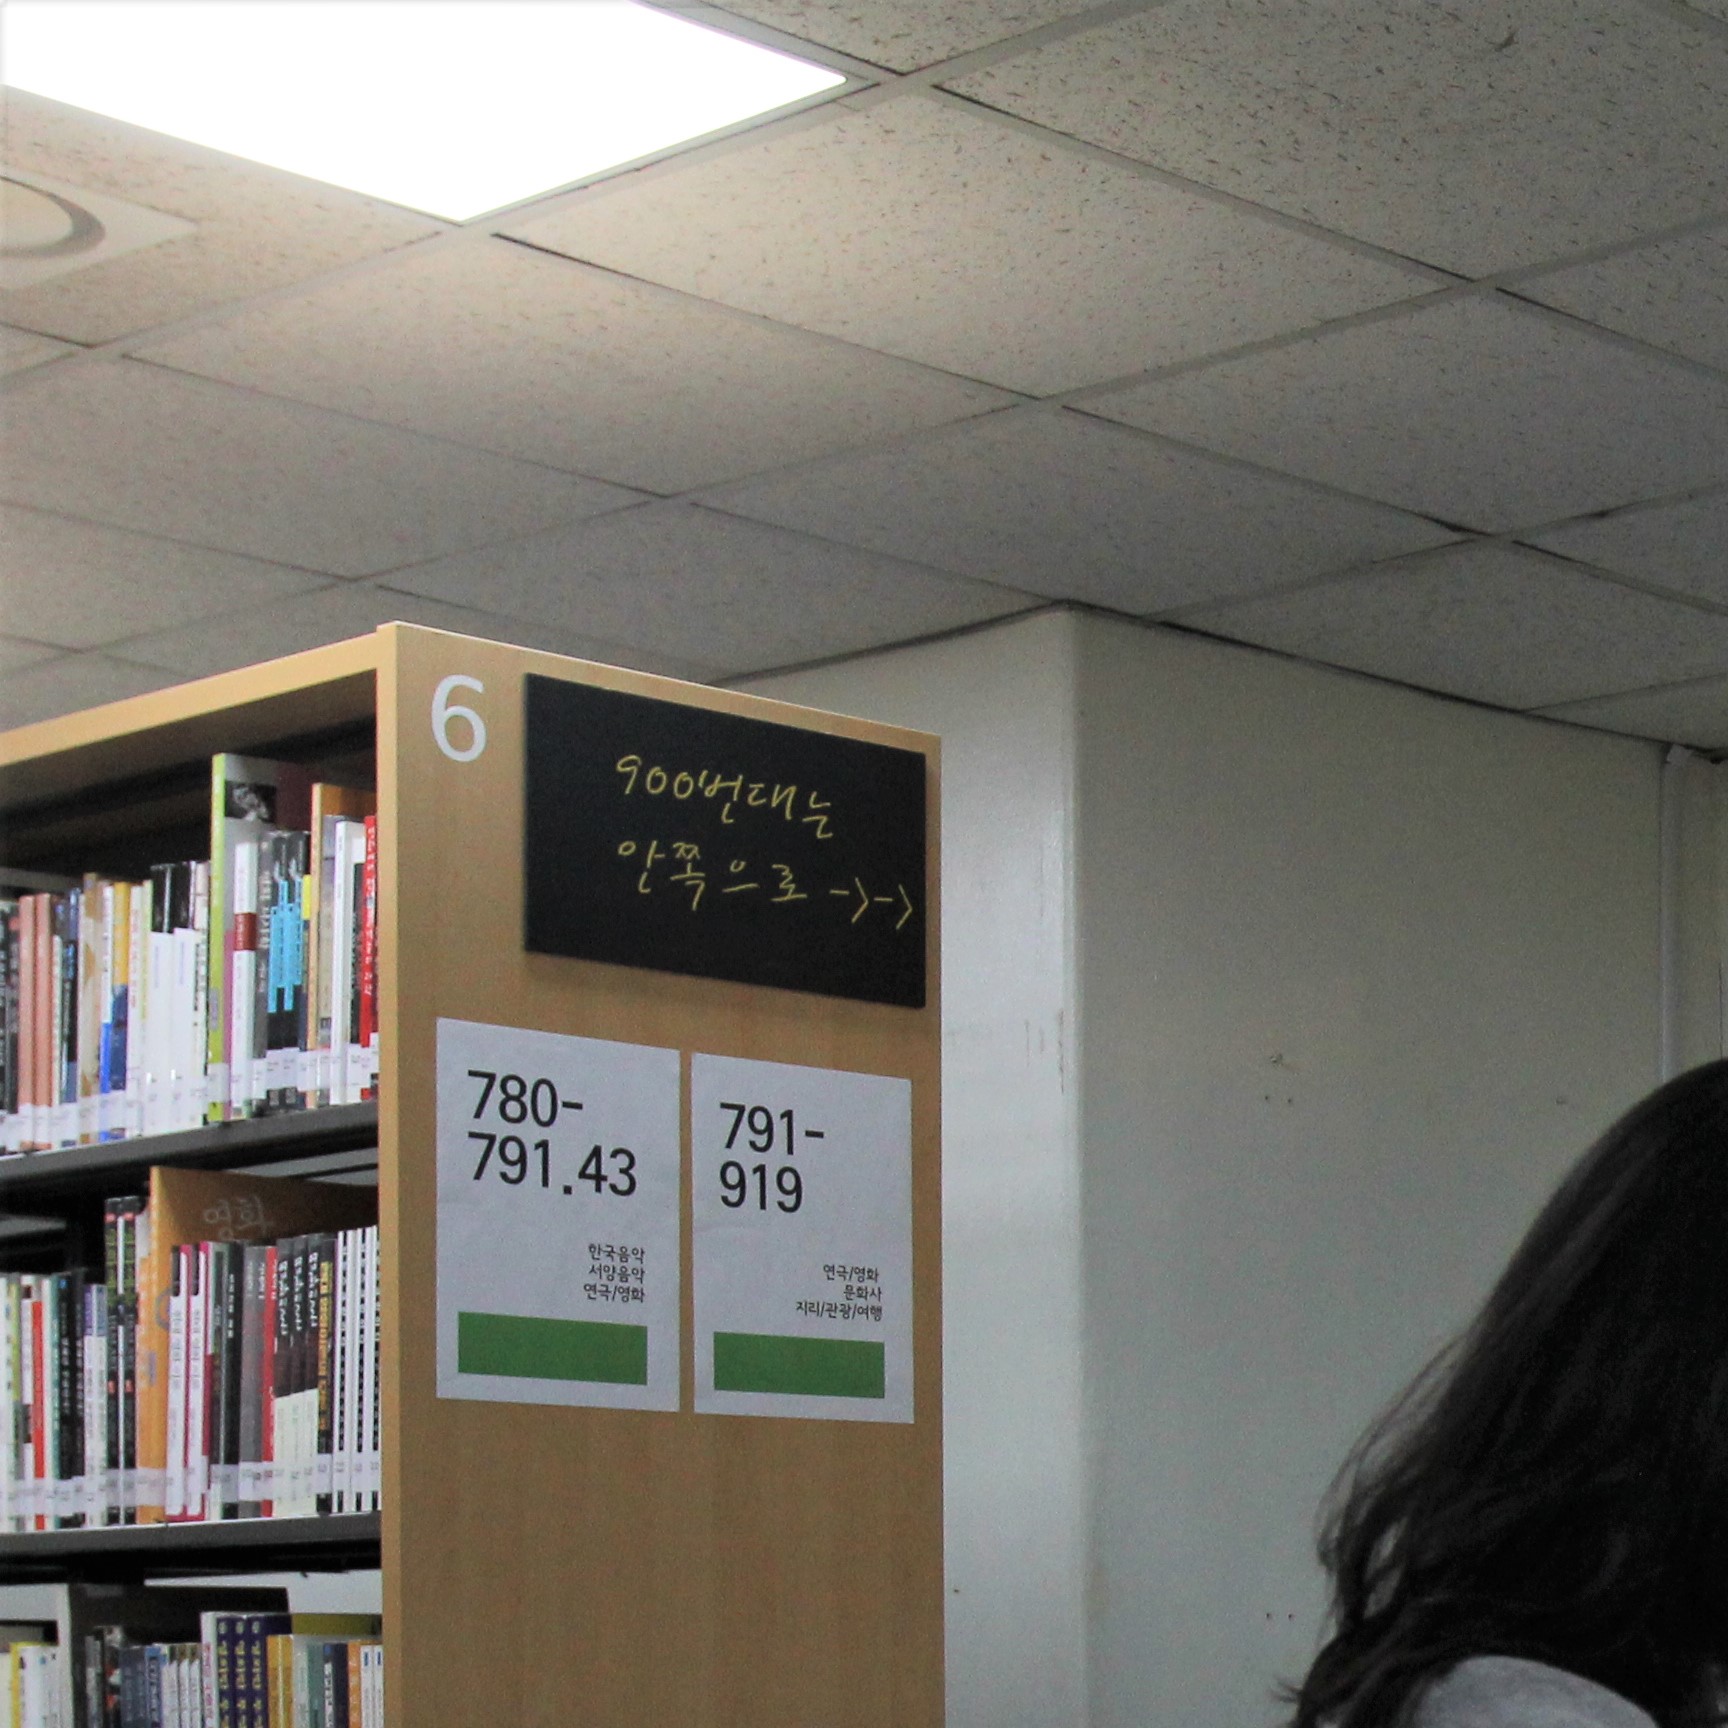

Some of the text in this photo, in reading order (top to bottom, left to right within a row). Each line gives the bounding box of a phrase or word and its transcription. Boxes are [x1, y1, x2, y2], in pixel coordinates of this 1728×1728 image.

[430, 674, 488, 762] 6
[616, 754, 834, 839] 900번대는
[617, 840, 808, 912] 안쪽으로
[467, 1069, 584, 1130] 780-
[719, 1102, 825, 1158] 791-
[467, 1131, 637, 1199] 791.43
[719, 1161, 804, 1213] 919
[588, 1243, 646, 1265] 한국음악
[588, 1263, 646, 1285] 서양음악
[823, 1264, 880, 1284] 연극/영화
[583, 1282, 646, 1304] 연극/영화
[796, 1300, 883, 1322] 지리/관광/여행
